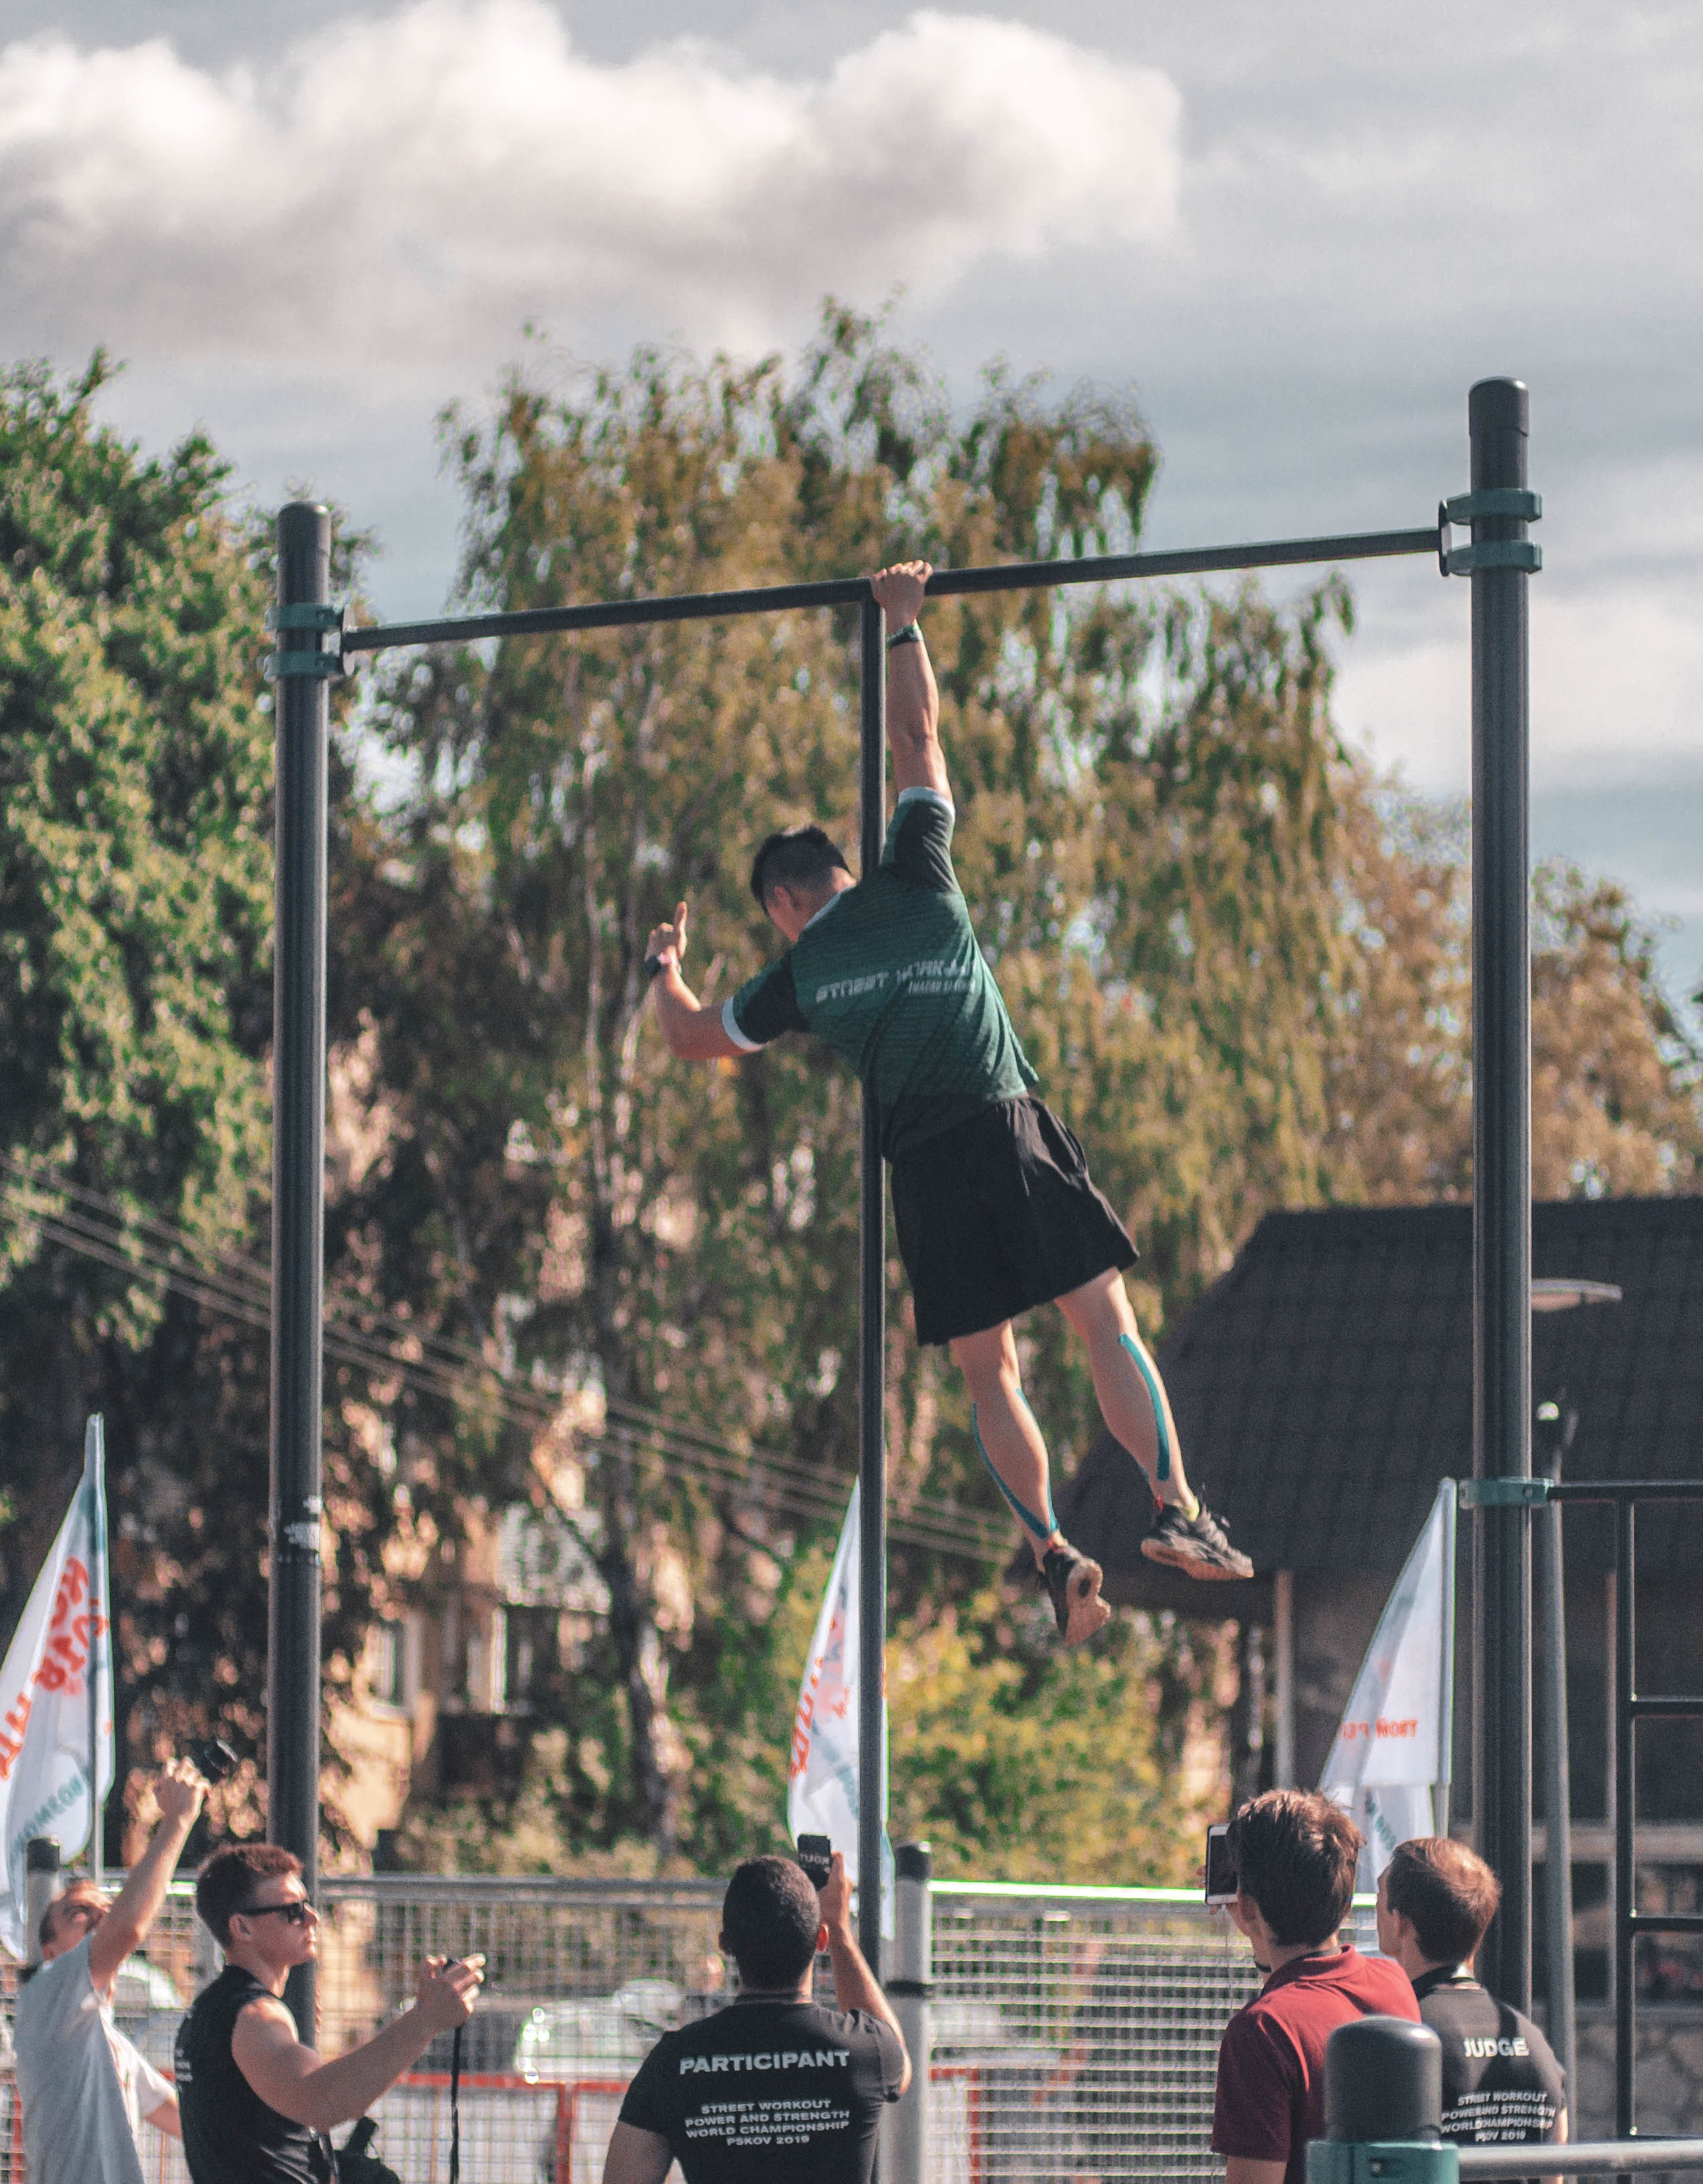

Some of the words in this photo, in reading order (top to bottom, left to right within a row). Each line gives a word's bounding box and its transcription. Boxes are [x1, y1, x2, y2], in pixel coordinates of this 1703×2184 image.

[1463, 2037, 1530, 2057] JUDGE
[679, 2050, 850, 2075] PARTICIPANT
[701, 2104, 755, 2114] STREET
[758, 2100, 831, 2110] WORKOUT
[685, 2116, 735, 2128] POWER
[739, 2113, 770, 2123] AND
[774, 2110, 850, 2122] STRENGTH
[1482, 2117, 1553, 2130] HAMPIONSHP
[686, 2127, 736, 2138] WORLD
[739, 2121, 850, 2134] CHAMPIONSHIP
[727, 2136, 772, 2146] PSKOV
